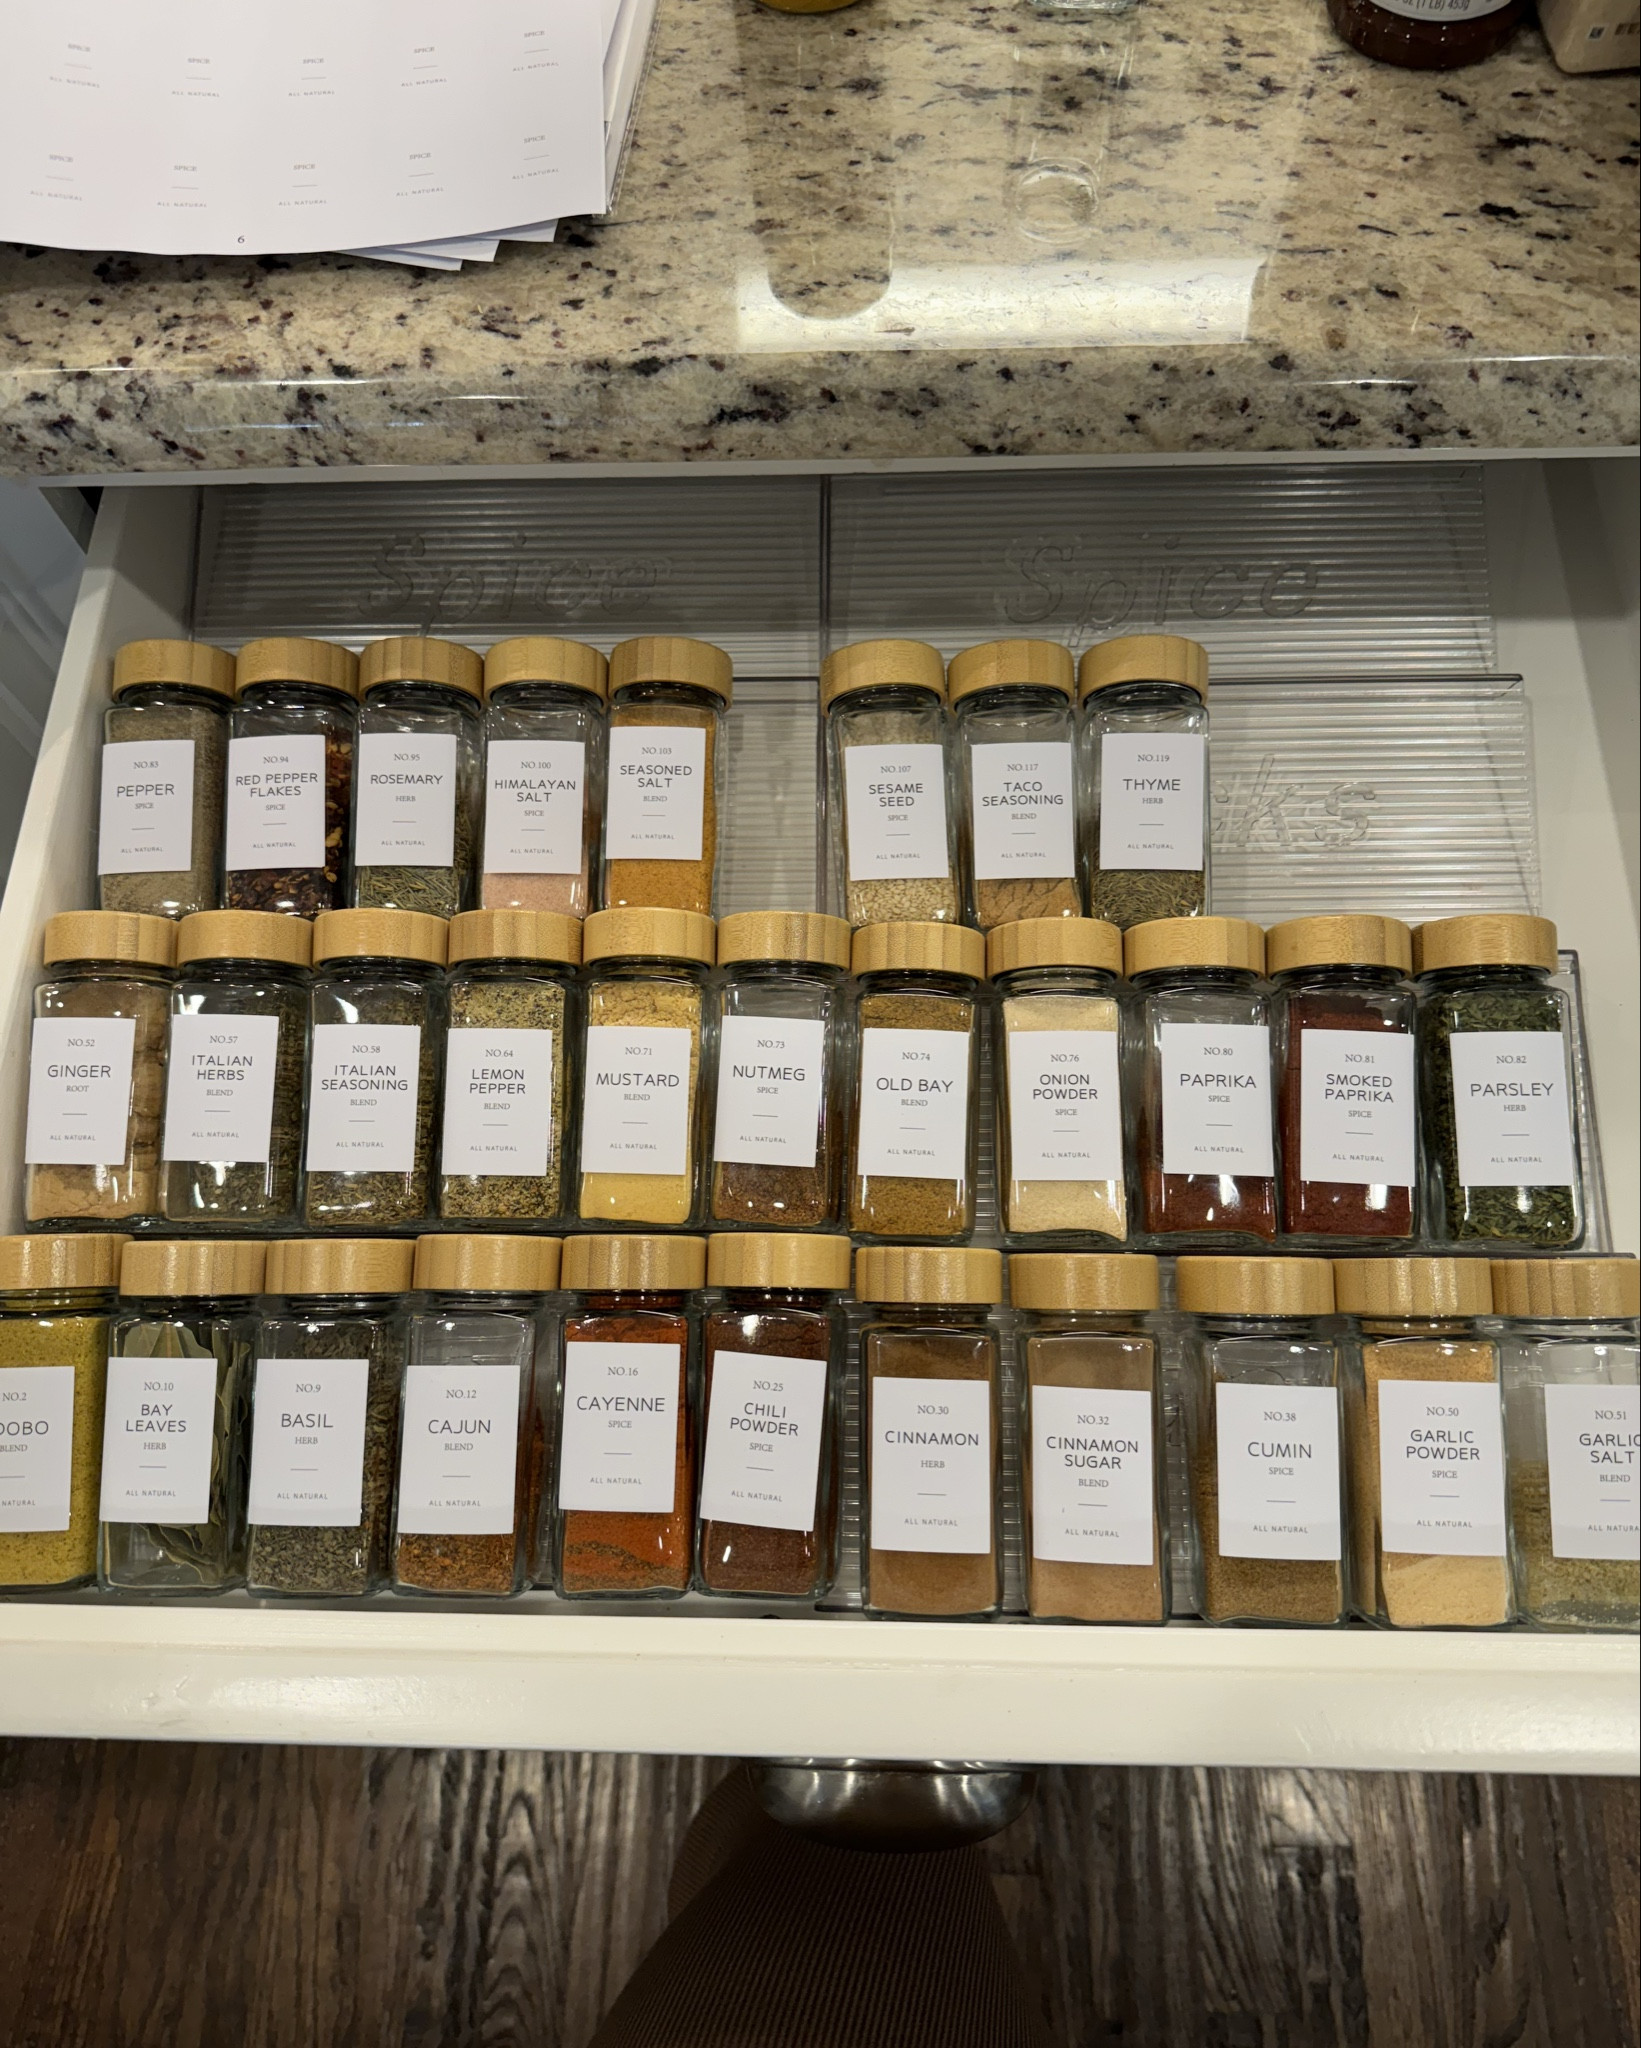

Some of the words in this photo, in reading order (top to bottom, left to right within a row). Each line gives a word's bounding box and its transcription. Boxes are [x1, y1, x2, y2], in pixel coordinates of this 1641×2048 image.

[523, 30, 546, 39] SPICE
[412, 46, 436, 54] SPICE
[302, 57, 325, 65] SPICE
[523, 134, 546, 145] SPICE
[409, 152, 432, 161] SPICE
[173, 164, 198, 172] SPICE
[292, 163, 316, 171] SPICE
[236, 234, 246, 245] 6
[1003, 533, 1319, 648] Spice
[641, 746, 673, 755] NO.103
[262, 755, 289, 765] NO.94
[393, 753, 421, 762] NO.95
[1137, 753, 1171, 763] NO.119
[133, 760, 159, 770] NO.83
[520, 760, 552, 770] NO.100
[619, 764, 693, 777] SEASONED
[880, 765, 912, 774] NO.107
[1006, 763, 1039, 772] NO.117
[235, 774, 262, 787] RED
[265, 772, 319, 784] PEPPER
[370, 773, 444, 785] ROSEMARY
[494, 778, 577, 791] HIMALAYAN
[637, 777, 673, 789] SALT
[116, 783, 175, 798] PEPPER
[868, 782, 924, 795] SESAME
[1002, 781, 1043, 793] TACO
[1122, 778, 1182, 792] THYME
[249, 785, 302, 799] FLAKES
[516, 791, 553, 803] SALT
[395, 795, 417, 803] HERB
[642, 795, 668, 803] BLEND
[878, 795, 915, 808] SEED
[981, 794, 1064, 807] SEASONING
[1142, 797, 1164, 805] HERB
[134, 801, 154, 810] SPICE
[265, 803, 286, 811] SPICE
[523, 809, 545, 817] SPICE
[887, 814, 909, 822] SPICE
[1011, 812, 1038, 821] BLEND
[67, 1038, 96, 1048] NO.52
[209, 1034, 239, 1044] NO.57
[756, 1039, 786, 1049] NO.73
[351, 1044, 381, 1054] NO.58
[485, 1048, 514, 1058] NO.64
[624, 1046, 653, 1056] NO.71
[1203, 1046, 1234, 1057] NO.80
[191, 1054, 254, 1067] ITALIAN
[901, 1051, 931, 1062] NO.74
[1050, 1053, 1080, 1063] NO.76
[1344, 1053, 1375, 1064] NO.81
[1495, 1054, 1528, 1065] NO.82
[46, 1064, 112, 1079] GINGER
[196, 1068, 245, 1081] HERBS
[334, 1064, 397, 1077] ITALIAN
[471, 1068, 525, 1081] LEMON
[732, 1064, 806, 1082] NUTMEG
[320, 1078, 409, 1091] SEASONING
[595, 1072, 680, 1088] MUSTARD
[1039, 1073, 1091, 1086] ONION
[1179, 1073, 1258, 1089] PAPRIKA
[1325, 1073, 1393, 1088] SMOKED
[65, 1084, 90, 1093] ROOT
[469, 1082, 526, 1095] PEPPER
[756, 1086, 779, 1095] SPICE
[875, 1077, 913, 1092] OLD
[917, 1078, 954, 1094] BAY
[1470, 1082, 1555, 1098] PARSLEY
[206, 1088, 234, 1097] BLEND
[623, 1093, 651, 1102] BLEND
[1032, 1088, 1099, 1101] POWDER
[1324, 1087, 1395, 1104] PAPRIKA
[349, 1098, 378, 1107] BLEND
[900, 1098, 929, 1107] BLEND
[1207, 1094, 1231, 1103] SPICE
[483, 1102, 511, 1111] BLEND
[1054, 1108, 1078, 1116] SPICE
[1503, 1104, 1527, 1112] HERB
[1347, 1109, 1373, 1119] SPICE
[1210, 1146, 1244, 1154] NATURAL
[1349, 1154, 1385, 1163] NATURAL
[607, 1366, 639, 1377] NO.16
[143, 1381, 175, 1392] NO.10
[295, 1383, 322, 1394] NO.9
[752, 1379, 784, 1392] NO.25
[1, 1391, 27, 1402] NO.2
[445, 1388, 477, 1399] NO.12
[576, 1395, 666, 1413] CAYENNE
[140, 1403, 174, 1417] BAY
[743, 1401, 787, 1419] CHILI
[917, 1404, 950, 1416] NO.30
[1425, 1406, 1460, 1417] NO.50
[1594, 1409, 1627, 1421] NO.51
[280, 1412, 334, 1429] BASIL
[1076, 1414, 1110, 1426] NO.32
[1263, 1411, 1297, 1422] NO.38
[125, 1419, 187, 1433] LEAVES
[427, 1418, 491, 1435] CAJUN
[607, 1419, 633, 1429] SPICE
[729, 1416, 799, 1437] POWDER
[294, 1436, 319, 1445] HERB
[884, 1430, 980, 1447] CINNAMON
[1409, 1428, 1475, 1444] GARLIC
[0, 1444, 28, 1453] BLEND
[143, 1441, 167, 1451] HERB
[444, 1442, 474, 1452] BLEND
[748, 1441, 774, 1453] SPICE
[1045, 1435, 1139, 1454] CINNAMON
[1247, 1441, 1312, 1460] CUMIN
[1405, 1445, 1481, 1461] POWDER
[1063, 1453, 1122, 1470] SUGAR
[1589, 1449, 1636, 1465] SALT
[920, 1459, 946, 1469] HERB
[1268, 1466, 1295, 1476] SPICE
[1431, 1469, 1458, 1479] SPICE
[606, 1477, 642, 1485] NATURAL
[1077, 1477, 1110, 1488] BLEND
[1599, 1473, 1631, 1483] BLEND
[141, 1489, 176, 1497] NATURAL
[293, 1492, 328, 1501] NATURAL
[747, 1491, 783, 1503] NATURAL
[1, 1499, 36, 1507] NATURAL
[445, 1499, 481, 1507] NATURAL
[921, 1518, 958, 1527] NATURAL
[1435, 1520, 1473, 1529] NATURAL
[1606, 1524, 1639, 1532] NATURA
[1082, 1528, 1120, 1538] NATURAL
[1271, 1525, 1309, 1534] NATURAL
